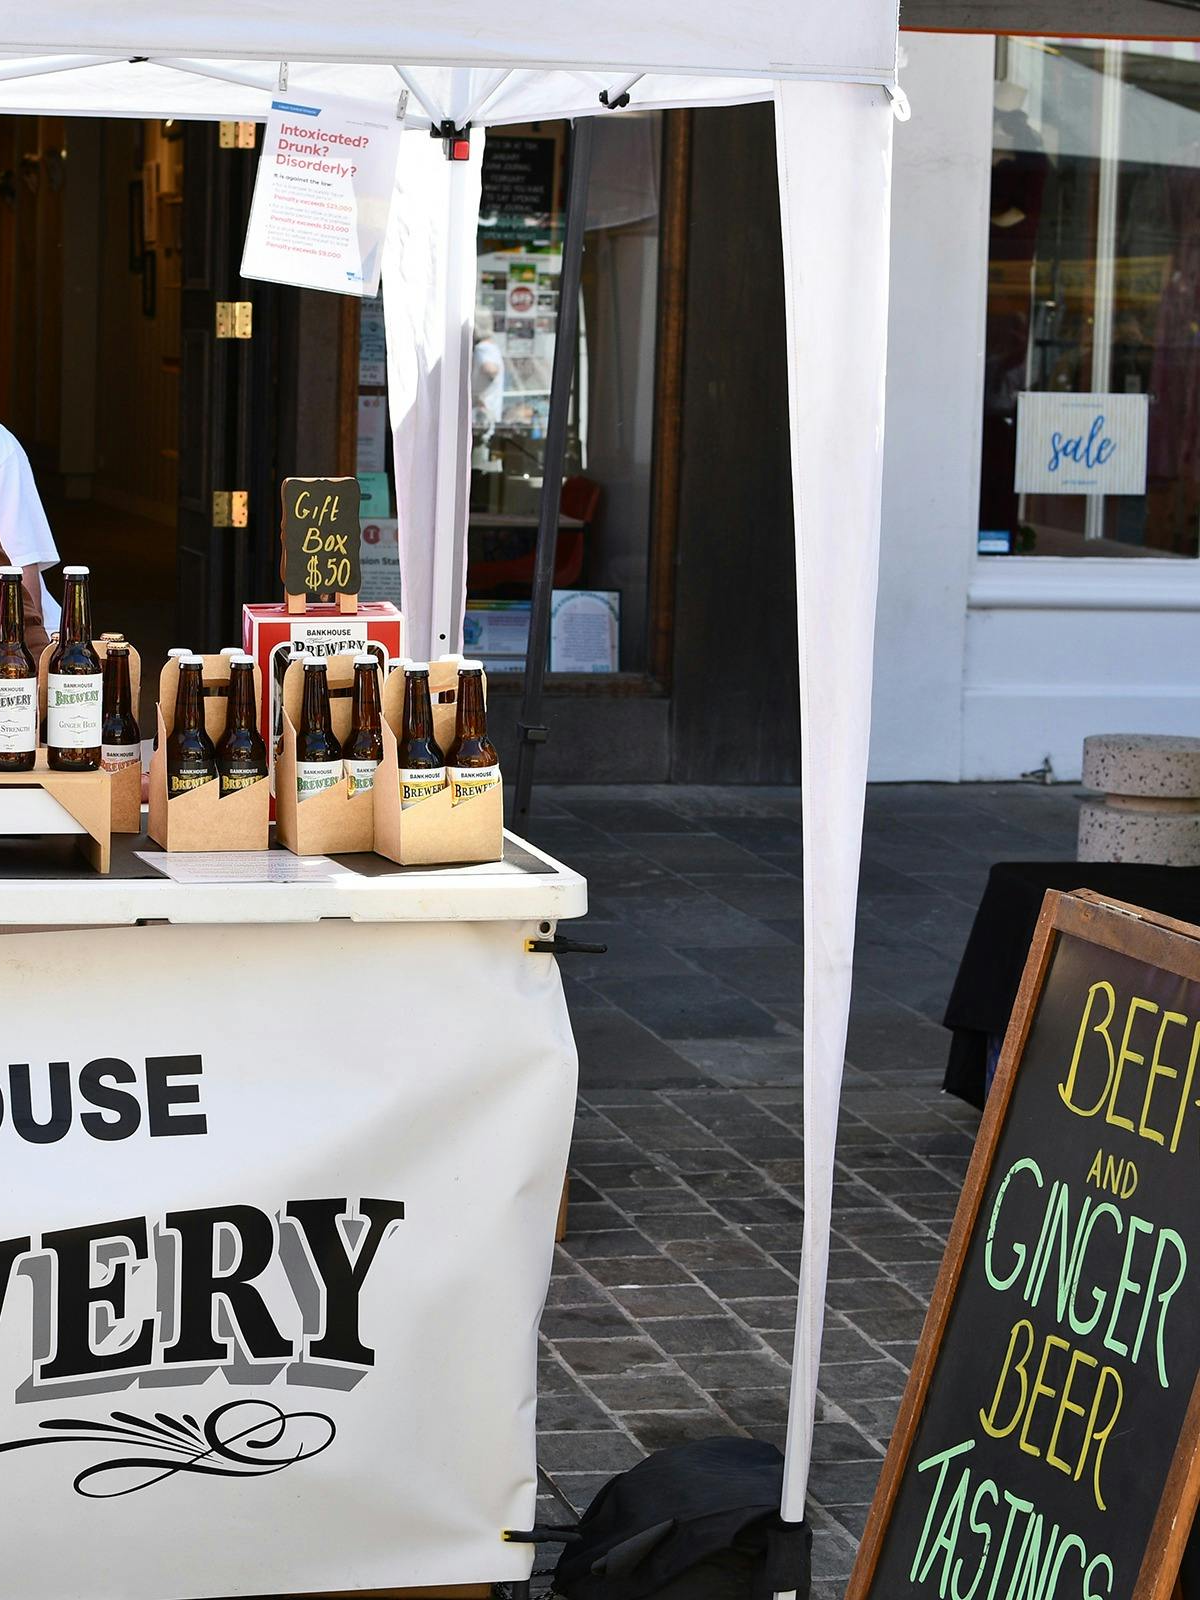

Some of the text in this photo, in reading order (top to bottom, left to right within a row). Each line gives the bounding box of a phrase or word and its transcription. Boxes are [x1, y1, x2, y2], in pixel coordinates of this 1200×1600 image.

[278, 138, 329, 157] Drunk?
[280, 123, 369, 148] Intoxicated?
[276, 153, 357, 178] Disorderly?
[1048, 415, 1117, 472] sale
[294, 491, 339, 526] Gift
[302, 528, 348, 554] Box
[305, 555, 351, 591] $50
[55, 690, 99, 706] BREWERY
[1085, 1147, 1139, 1199] AND
[984, 1157, 1187, 1388] GINGER
[979, 1318, 1123, 1511] BEER
